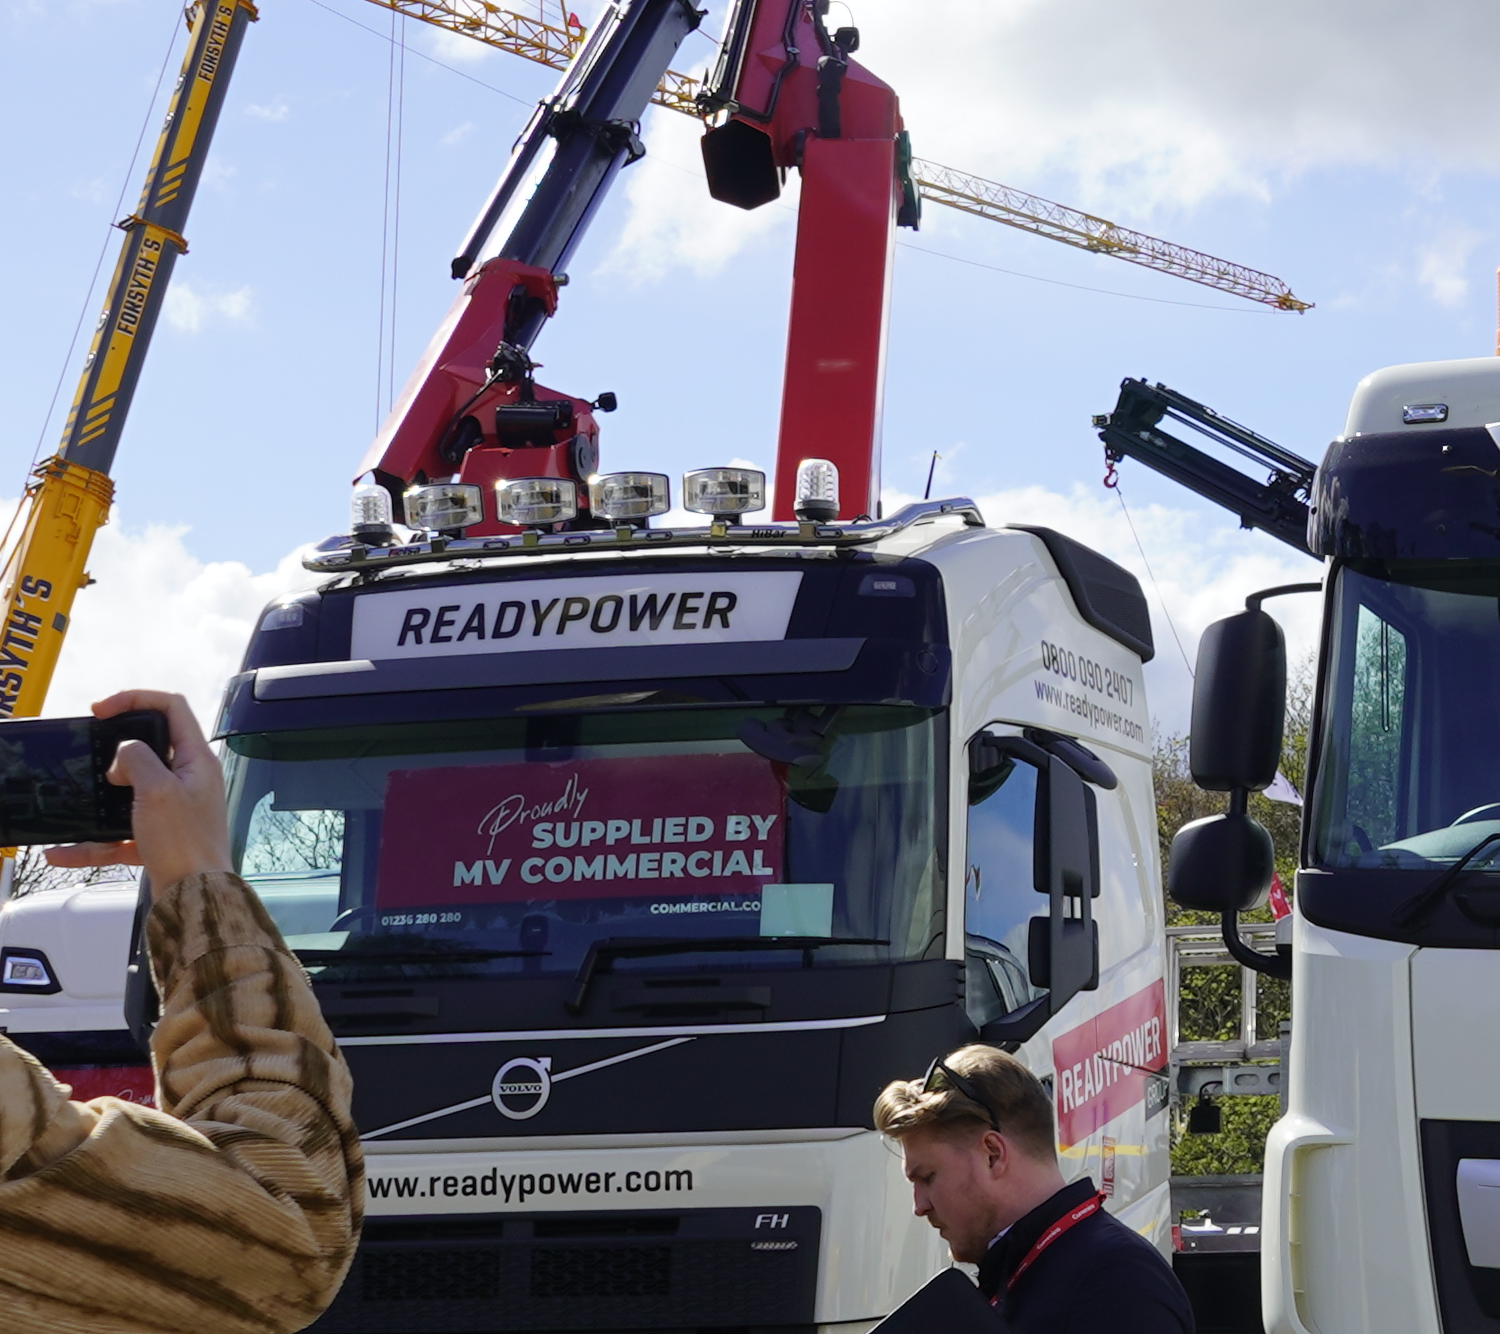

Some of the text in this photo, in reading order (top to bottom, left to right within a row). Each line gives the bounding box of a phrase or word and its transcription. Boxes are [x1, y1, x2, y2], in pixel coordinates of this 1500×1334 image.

[197, 4, 233, 85] FORSYTH'S
[116, 236, 161, 337] FORSYTH'S
[397, 591, 738, 647] READYPOWER
[1041, 640, 1133, 707] 0800 090 2407
[1034, 680, 1144, 744] www.readypower.com
[478, 773, 588, 856] Proudly
[532, 814, 778, 849] SUPPLIED BY
[453, 849, 773, 887] MV COMMERCIAL
[382, 912, 462, 927] 01236 280 280
[650, 901, 761, 915] COMMERCIAL.CO
[500, 1084, 543, 1093] VOLVO
[1061, 1016, 1161, 1114] READYPOWER
[368, 1168, 694, 1203] ww.readypower.com
[755, 1213, 790, 1229] FH
